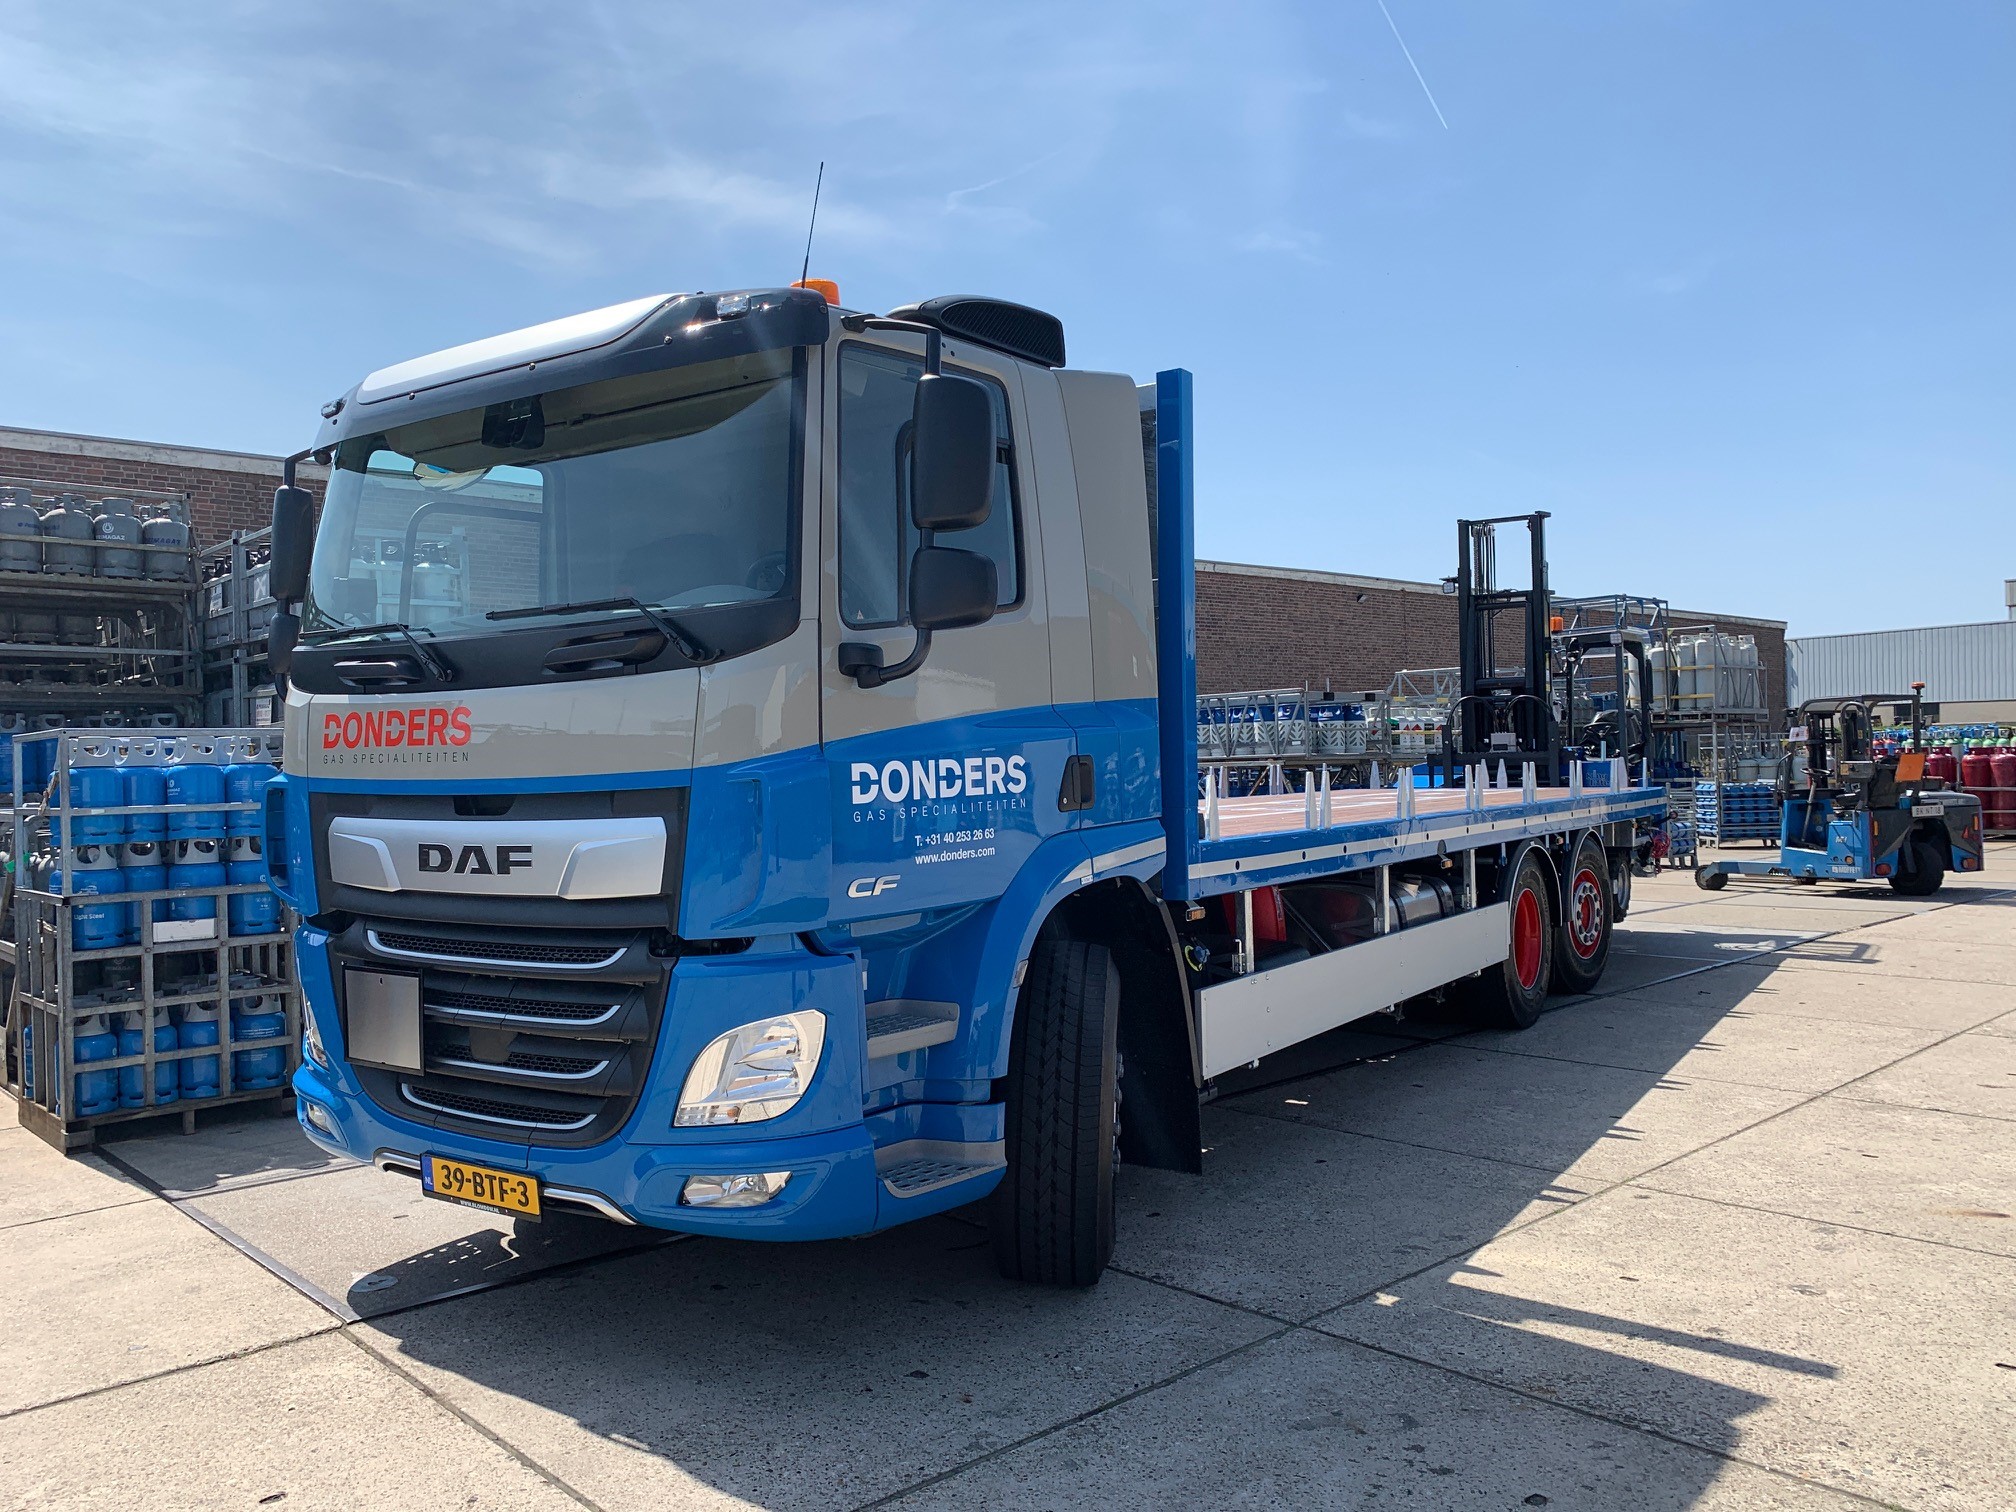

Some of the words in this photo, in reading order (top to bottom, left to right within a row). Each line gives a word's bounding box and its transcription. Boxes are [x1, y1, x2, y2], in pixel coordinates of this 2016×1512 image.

[323, 706, 472, 749] DONDERS
[323, 754, 344, 764] GAS
[353, 752, 469, 764] SPECIALITEITEN
[851, 755, 1027, 805] DONDERS
[853, 809, 886, 823] GAS
[900, 798, 1026, 819] SPECIALITEITEN
[914, 835, 924, 847] T.
[925, 833, 941, 846] +31
[943, 832, 955, 844] 40
[956, 830, 972, 843] 253
[973, 829, 984, 841] 26
[984, 828, 995, 840] 63
[418, 842, 533, 876] DAF
[915, 847, 996, 865] www.donders.com
[847, 874, 901, 899] CF
[424, 1176, 433, 1185] NL
[441, 1165, 530, 1207] 39-BTF-3
